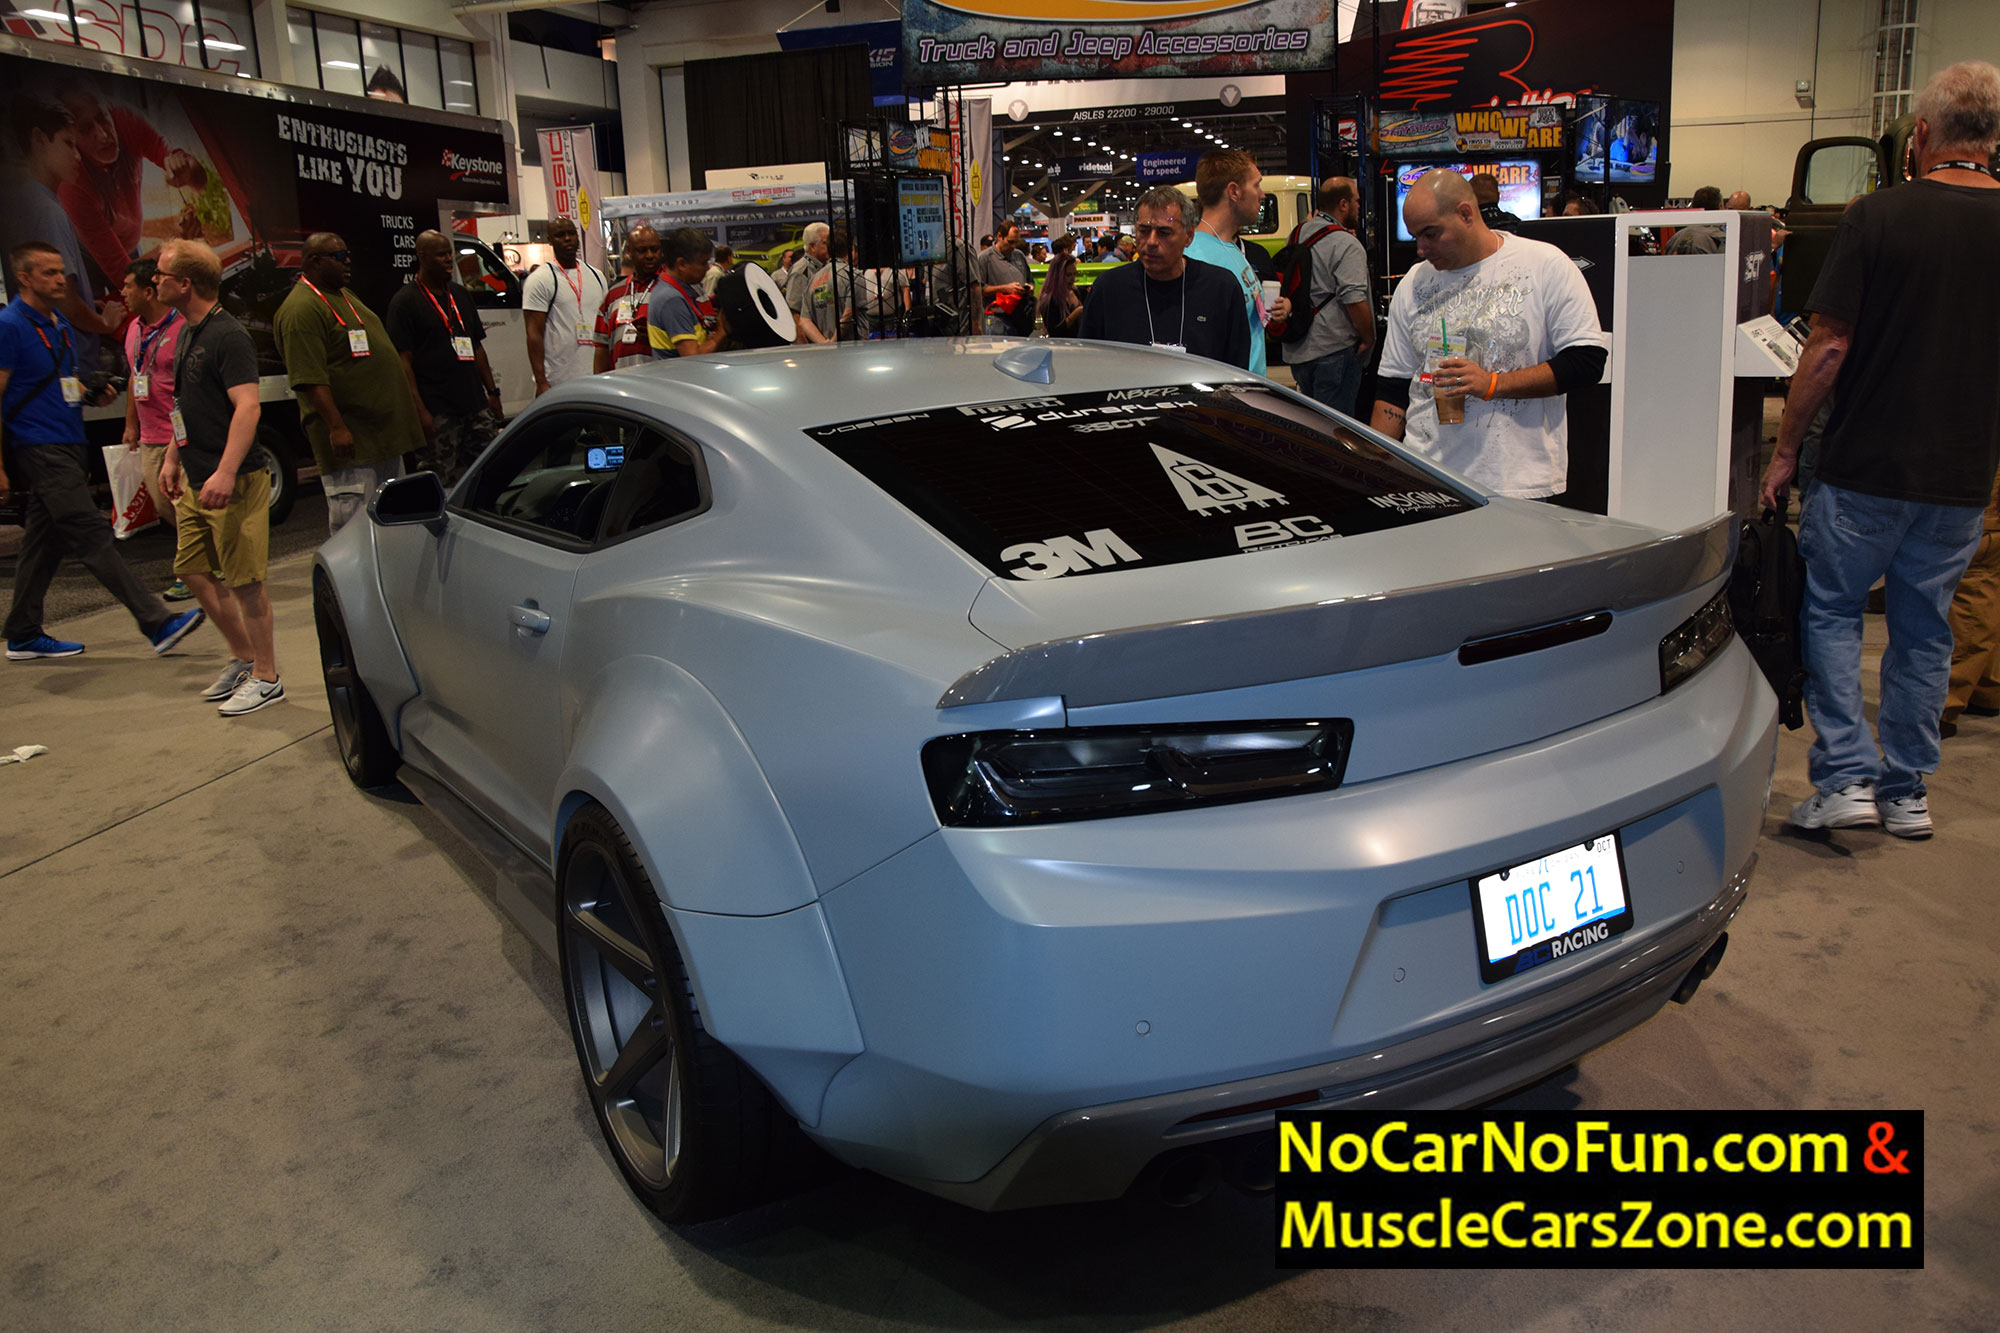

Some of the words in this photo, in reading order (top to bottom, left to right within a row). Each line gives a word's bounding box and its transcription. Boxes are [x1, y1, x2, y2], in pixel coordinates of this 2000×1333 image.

[919, 36, 996, 63] Truck
[1003, 31, 1060, 58] and
[1064, 31, 1132, 61] Jeep
[1138, 26, 1309, 56] Accessories
[1072, 109, 1105, 121] AISLES
[1107, 108, 1137, 119] 22200
[1144, 105, 1175, 117] 29000
[277, 114, 408, 166] ENTHUSIASTS
[1499, 117, 1529, 138] WE
[1527, 127, 1563, 148] ARE
[451, 152, 503, 176] Keystone
[1143, 157, 1187, 168] Engineered
[1143, 167, 1156, 175] for
[1158, 166, 1182, 175] speed.
[297, 153, 344, 186] LIKE
[346, 156, 402, 200] YOU
[1499, 166, 1530, 185] ARE
[731, 186, 796, 198] CLASSIC
[380, 214, 415, 230] TRUCKS
[393, 234, 417, 249] CARS
[1106, 386, 1180, 402] MBRP
[1234, 515, 1335, 549] BC
[1000, 528, 1143, 581] 3M
[1597, 838, 1611, 853] OCT
[1570, 864, 1604, 920] 21
[1551, 922, 1610, 959] RACING
